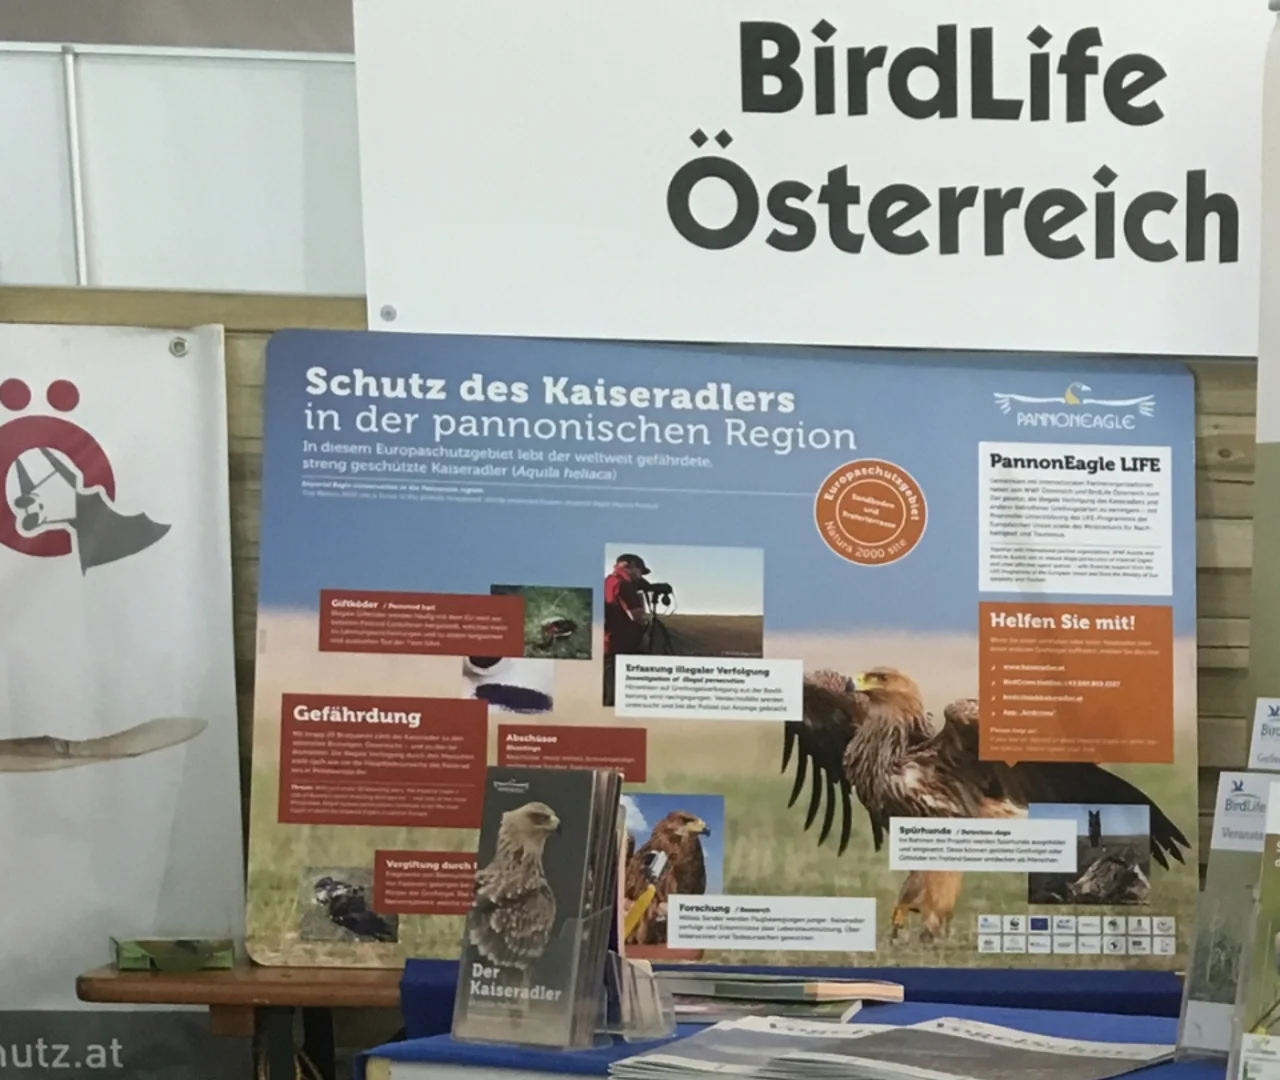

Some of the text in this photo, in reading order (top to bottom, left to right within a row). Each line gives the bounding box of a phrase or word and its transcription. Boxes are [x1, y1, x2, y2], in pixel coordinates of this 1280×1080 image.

[739, 18, 1168, 126] BirdLife
[666, 128, 1239, 263] Österreich
[305, 366, 795, 414] Schutz des Kaiseradlers
[304, 403, 858, 456] in der pannonischen Region
[1017, 411, 1136, 430] PANNONEAGLE
[303, 441, 317, 453] In
[321, 441, 372, 455] diesem
[376, 443, 514, 462] Europaschutzgebiet
[518, 448, 543, 462] lebt
[547, 449, 570, 463] der
[575, 451, 632, 466] weltweit
[990, 453, 1160, 474] PannonEagle LIFE
[302, 458, 346, 474] streng
[350, 457, 426, 475] geschützte
[431, 461, 508, 477] Kaiseradler
[824, 466, 919, 520] Europaschutzgebiet
[855, 547, 885, 559] 2000
[990, 613, 1136, 630] Helfen Sie mit!
[717, 666, 770, 677] Verfolgung
[293, 705, 422, 728] Gefährdung
[472, 963, 500, 978] Der
[470, 980, 562, 1001] Kaiseradler
